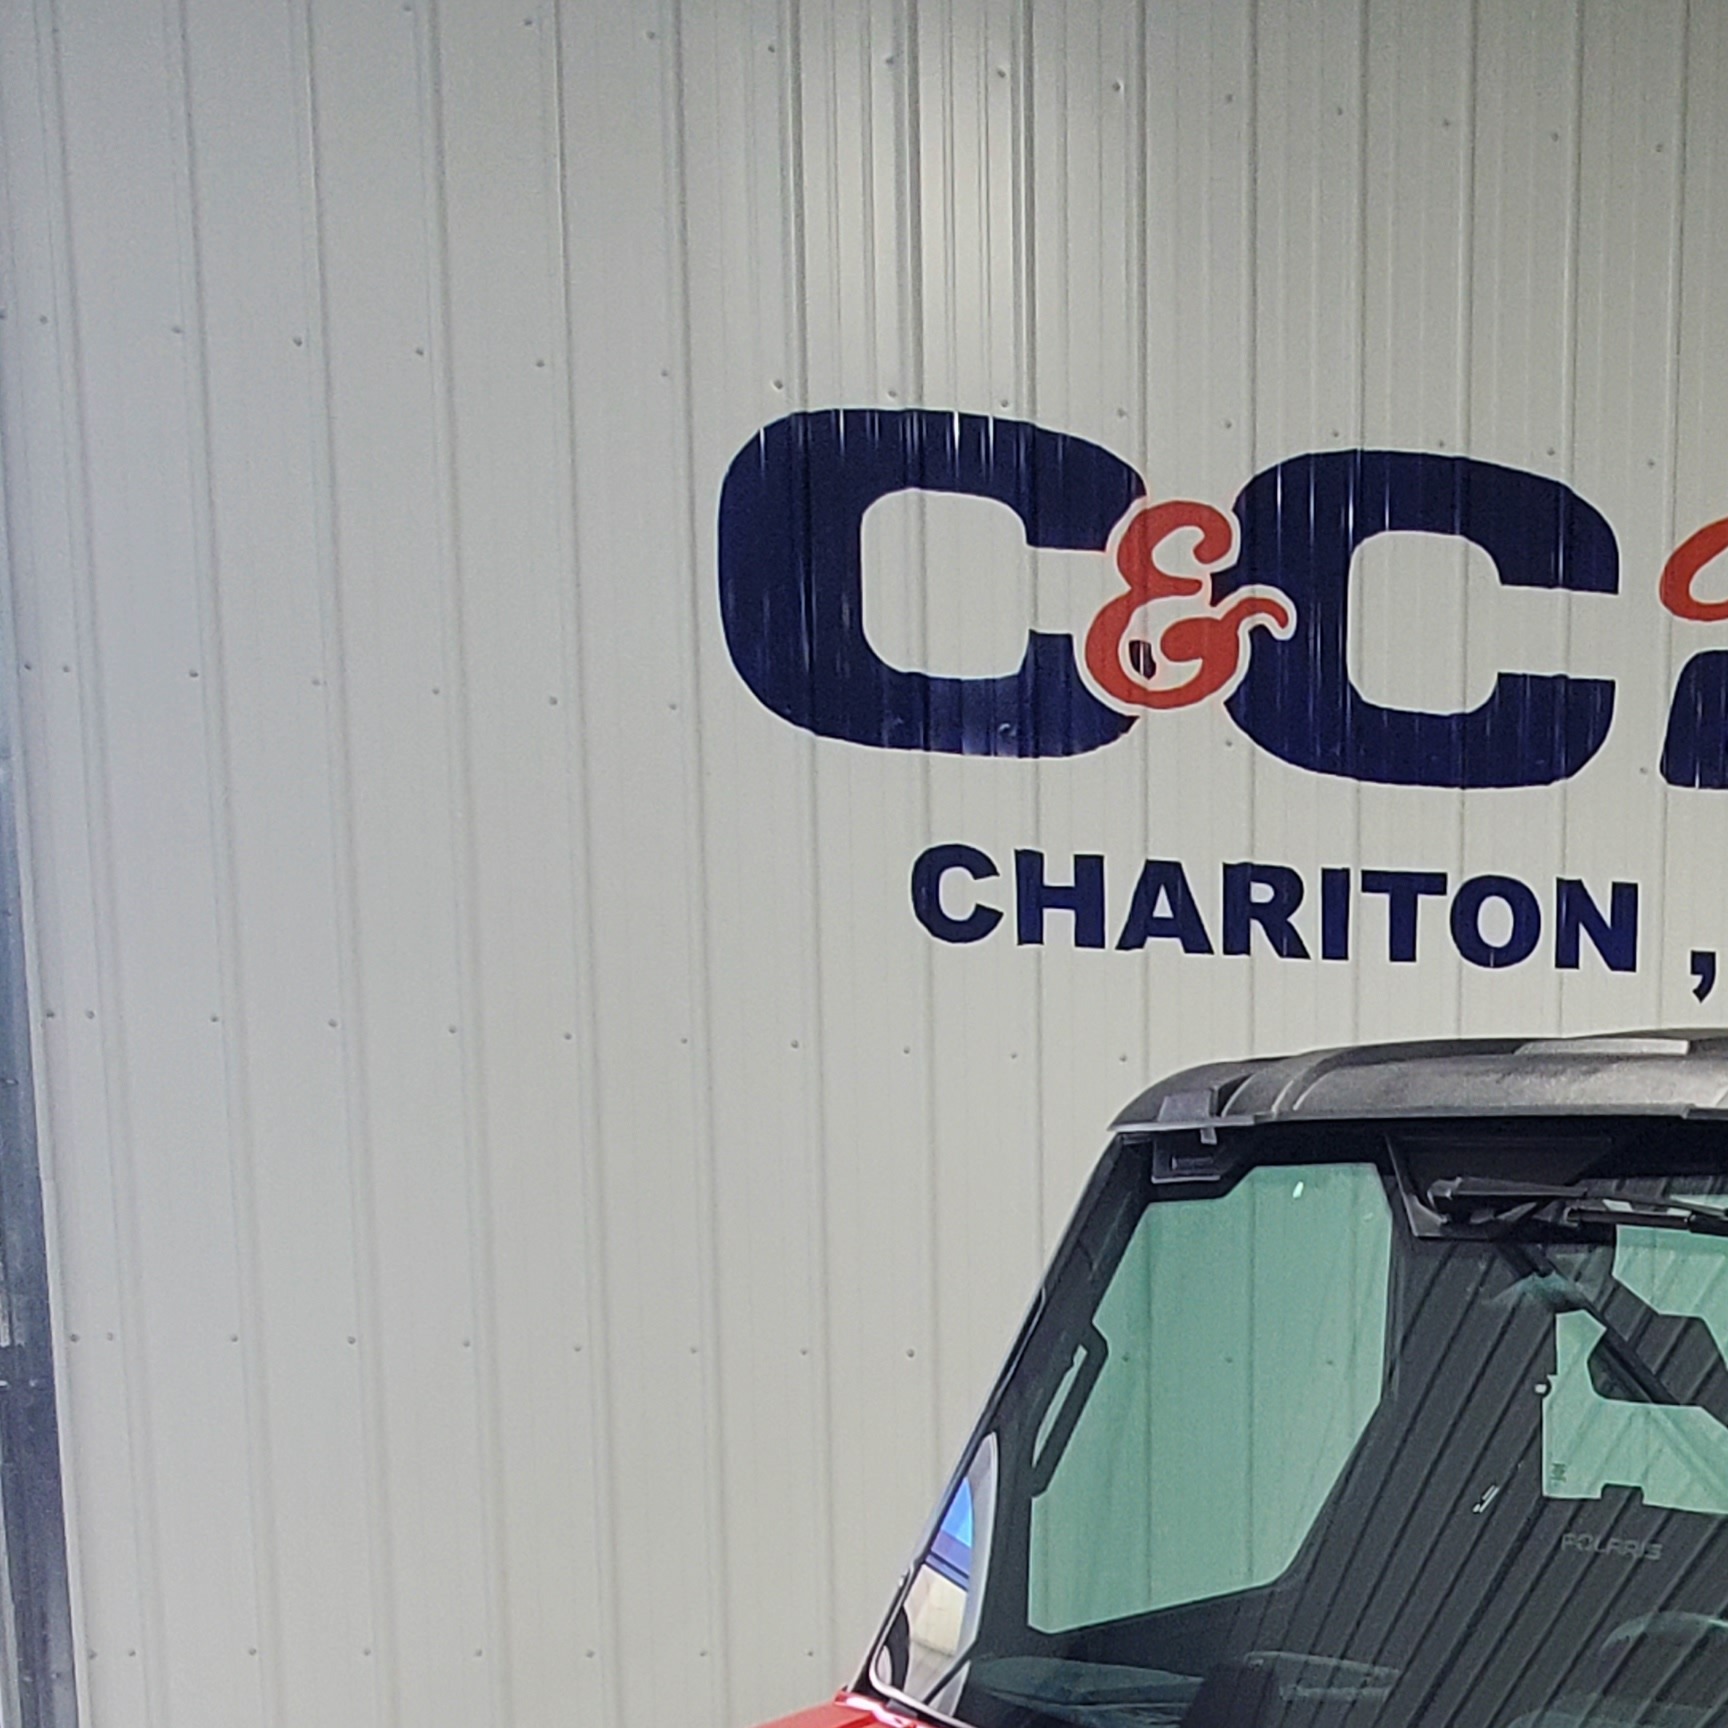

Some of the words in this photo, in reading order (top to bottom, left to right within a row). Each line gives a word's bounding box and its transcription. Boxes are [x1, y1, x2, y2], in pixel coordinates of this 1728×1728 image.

[717, 407, 1620, 790] C&C
[910, 843, 1640, 974] CHARITON
[1561, 1530, 1664, 1561] POLARIS
